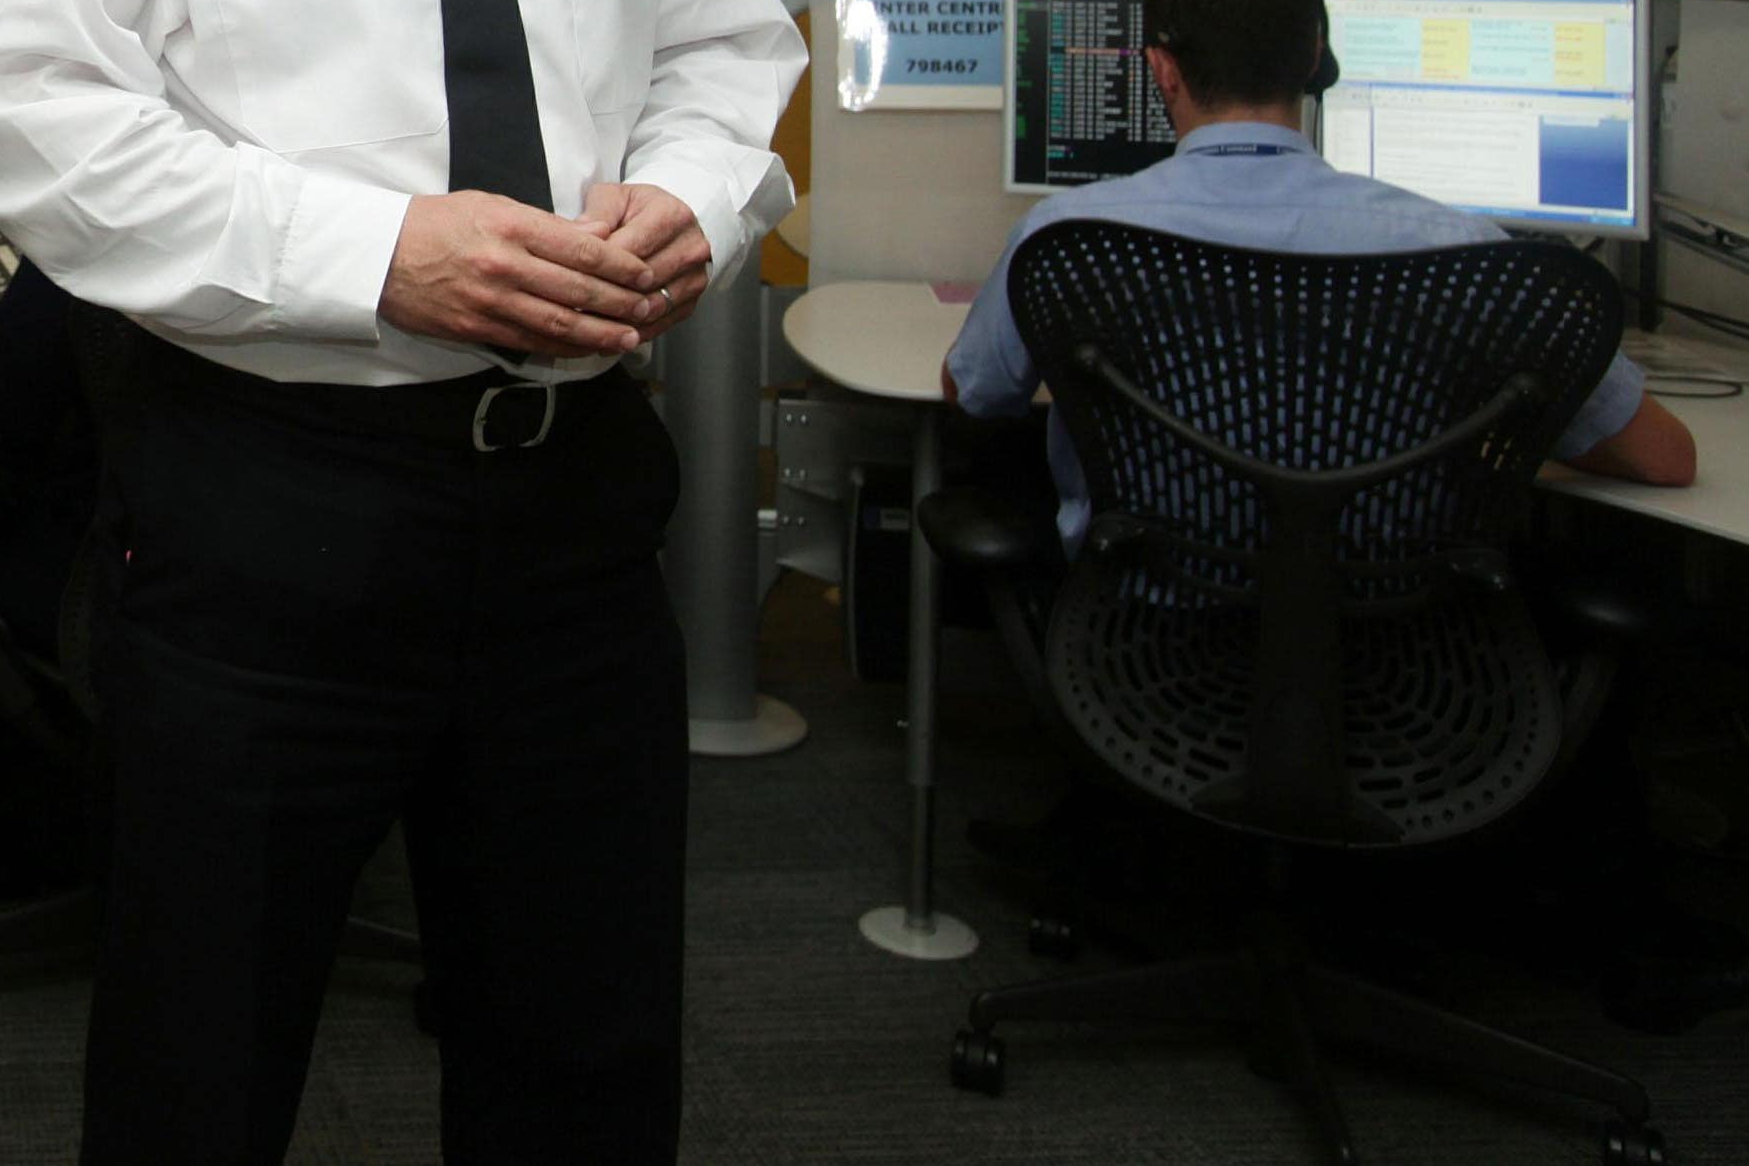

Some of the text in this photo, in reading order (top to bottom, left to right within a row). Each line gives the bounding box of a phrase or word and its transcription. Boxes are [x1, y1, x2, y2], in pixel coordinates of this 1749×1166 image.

[874, 0, 1004, 15] NTER CENTR
[887, 21, 921, 35] ALL
[907, 58, 979, 74] 798467
